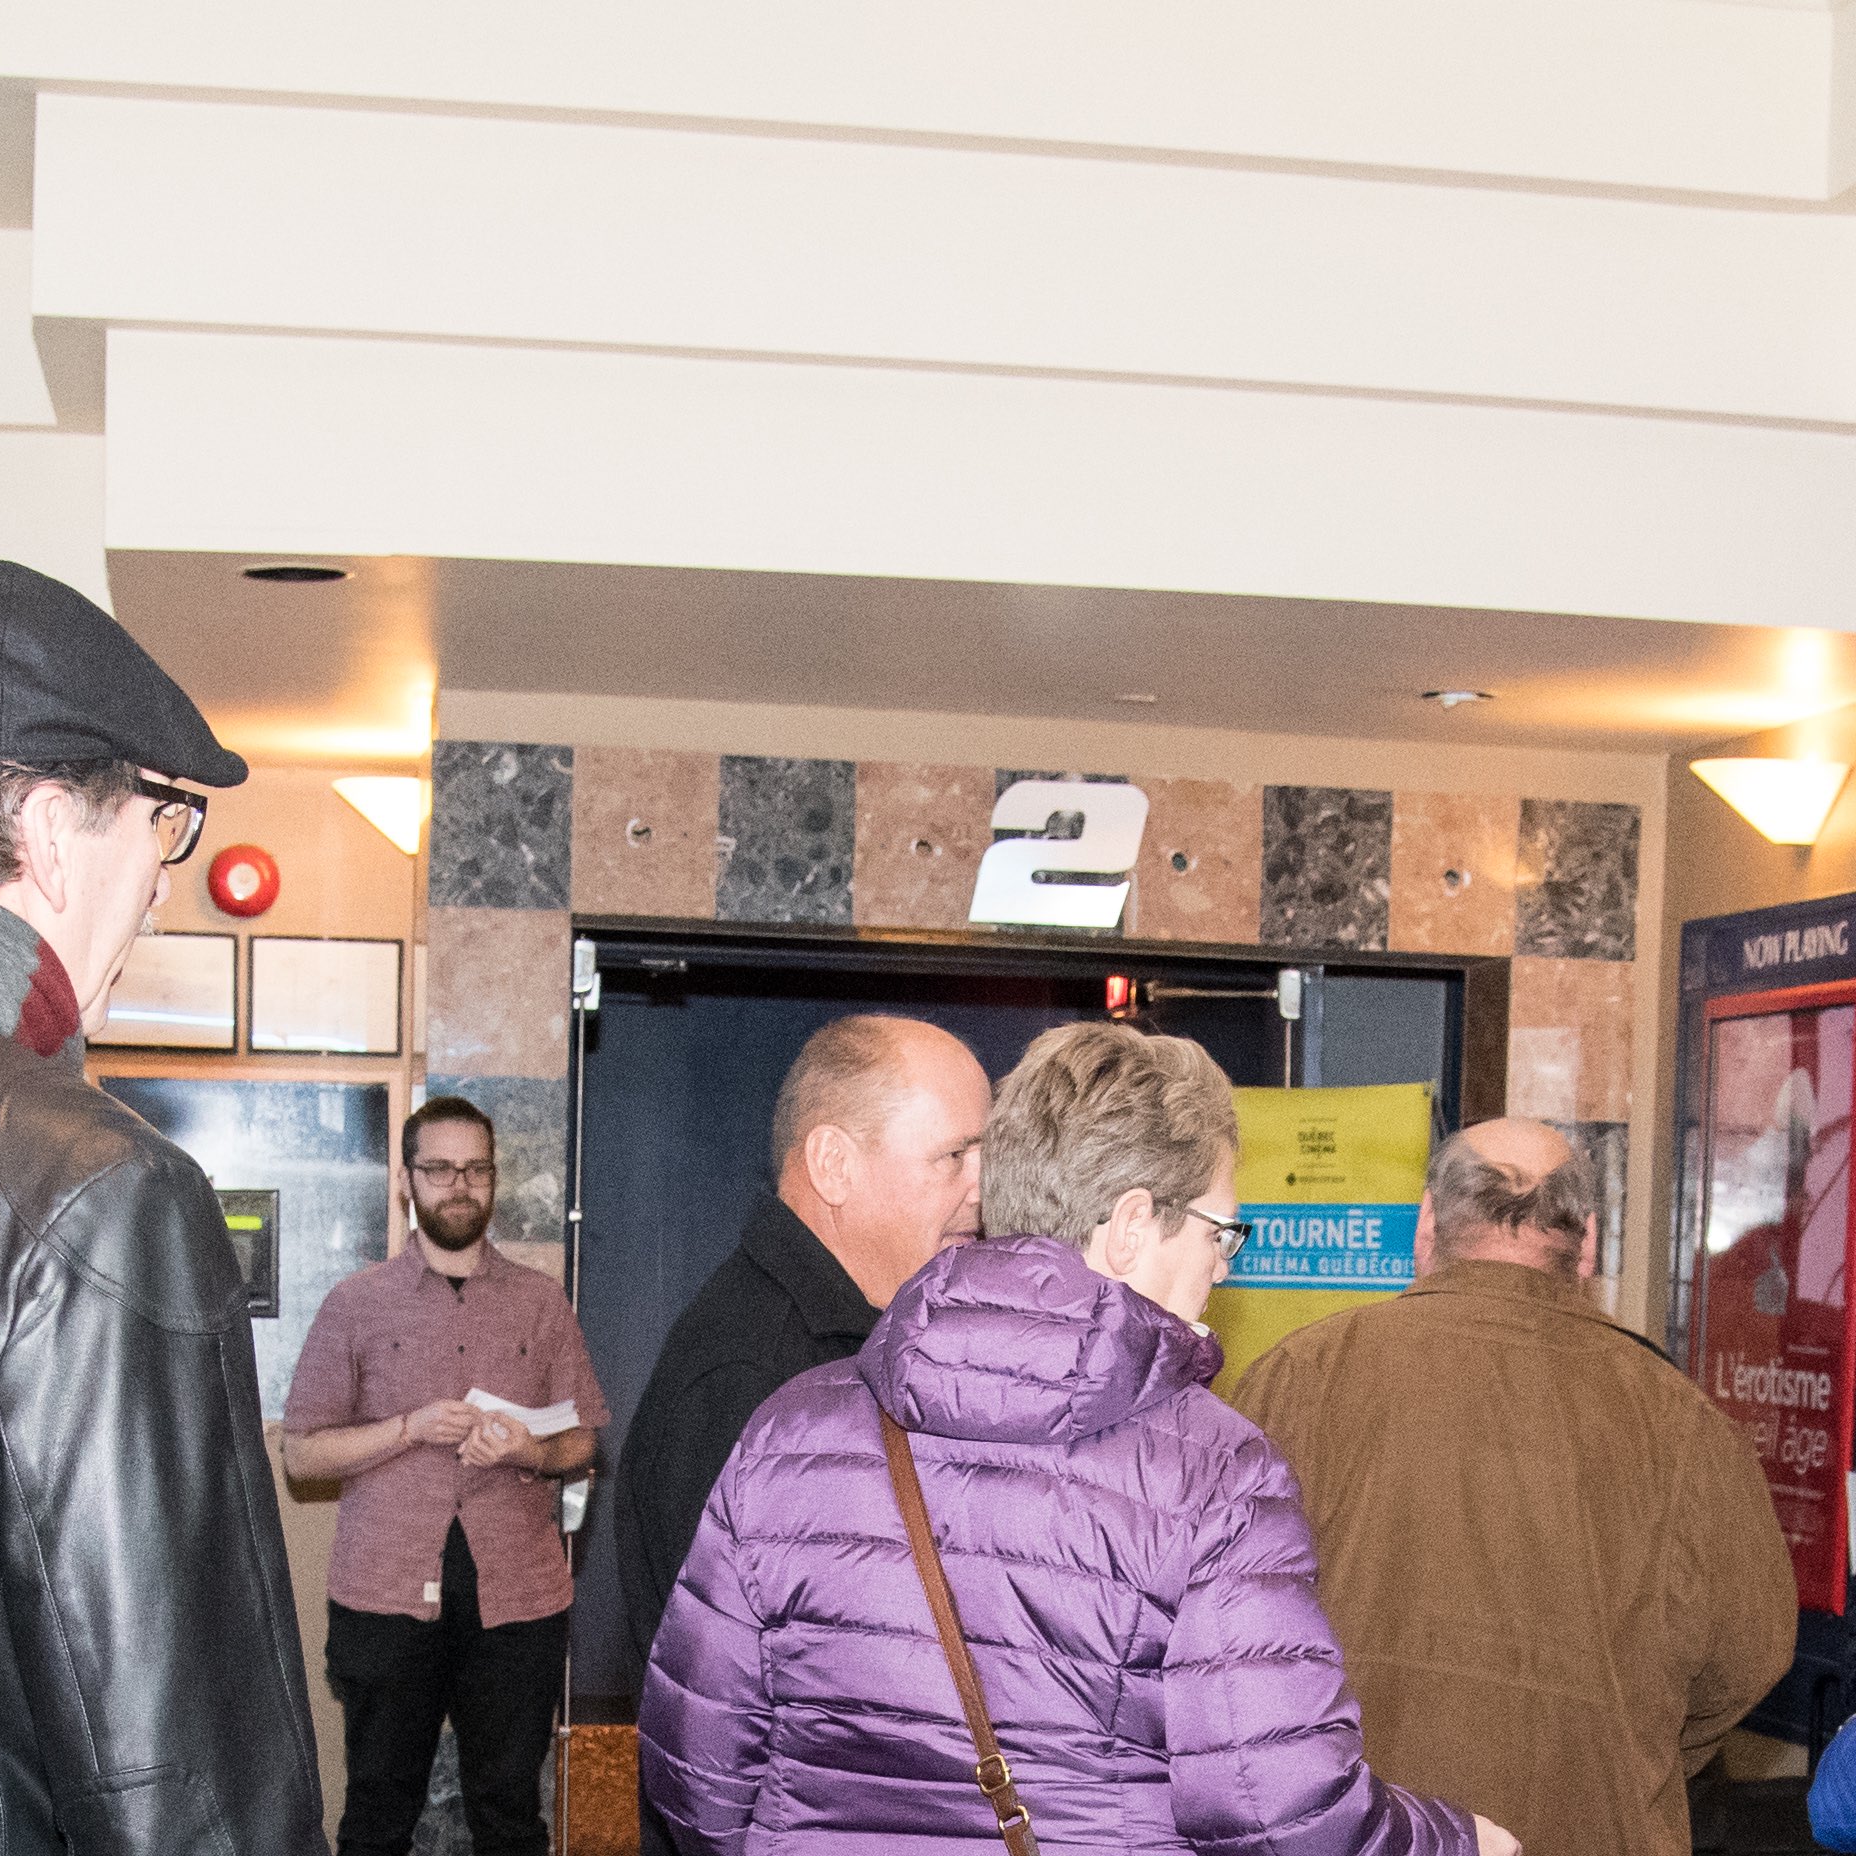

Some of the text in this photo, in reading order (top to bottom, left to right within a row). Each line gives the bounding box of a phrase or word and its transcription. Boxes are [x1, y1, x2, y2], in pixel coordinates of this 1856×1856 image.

[968, 779, 1150, 928] 2
[1743, 920, 1849, 969] NOW PLAYING
[1253, 1209, 1383, 1249] TOURNÉE
[1243, 1250, 1311, 1274] CINÉMA
[1715, 1352, 1832, 1412] L'érotisme
[1781, 1413, 1829, 1476] âge
